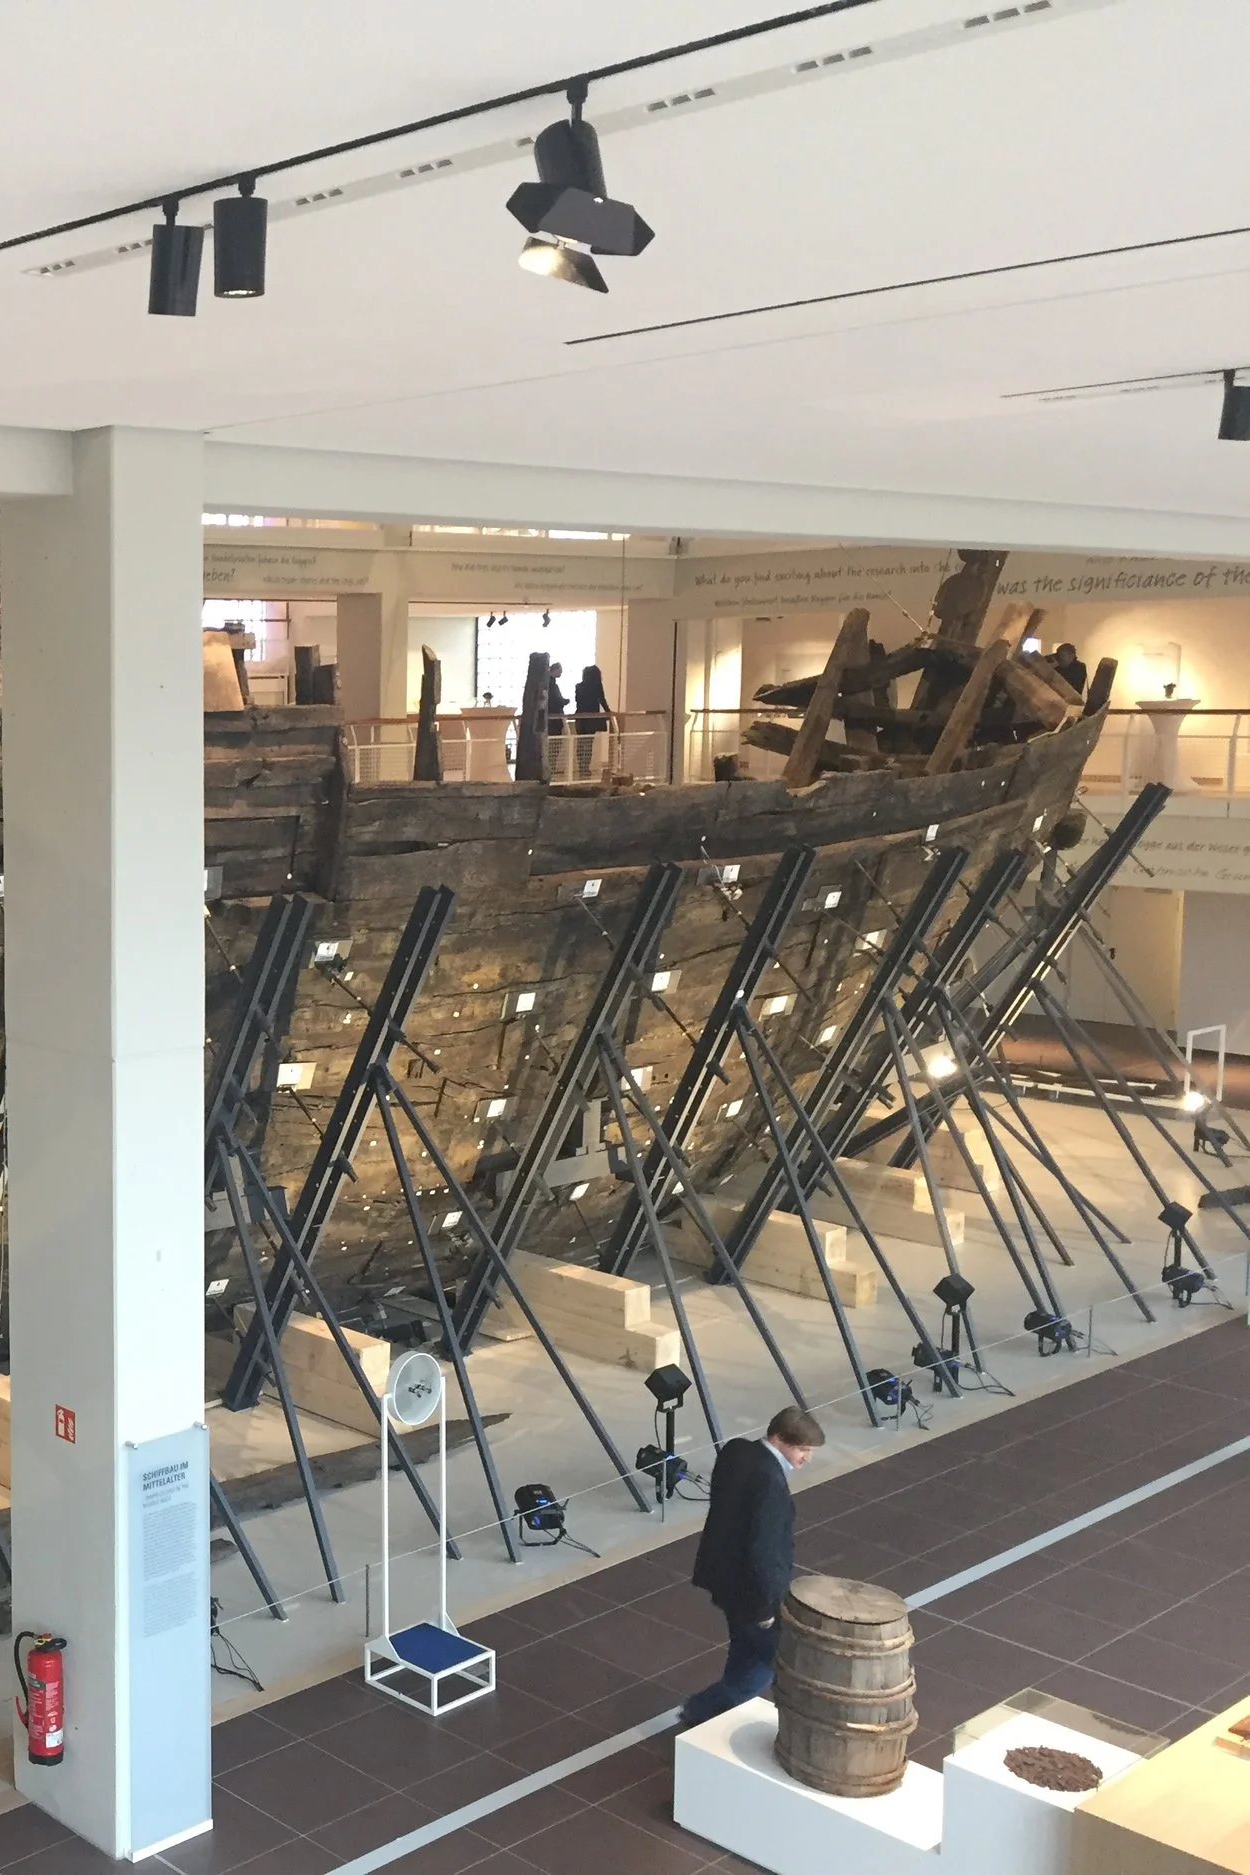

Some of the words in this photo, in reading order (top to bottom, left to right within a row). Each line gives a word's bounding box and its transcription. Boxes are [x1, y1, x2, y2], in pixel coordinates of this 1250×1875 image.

[720, 571, 732, 583] do
[814, 565, 843, 579] about
[996, 579, 1028, 596] was
[1033, 575, 1063, 593] the
[1192, 564, 1219, 588] of
[143, 1463, 179, 1481] SCHIFFBAU
[180, 1460, 189, 1471] IM
[143, 1472, 186, 1491] MITTELALTER
